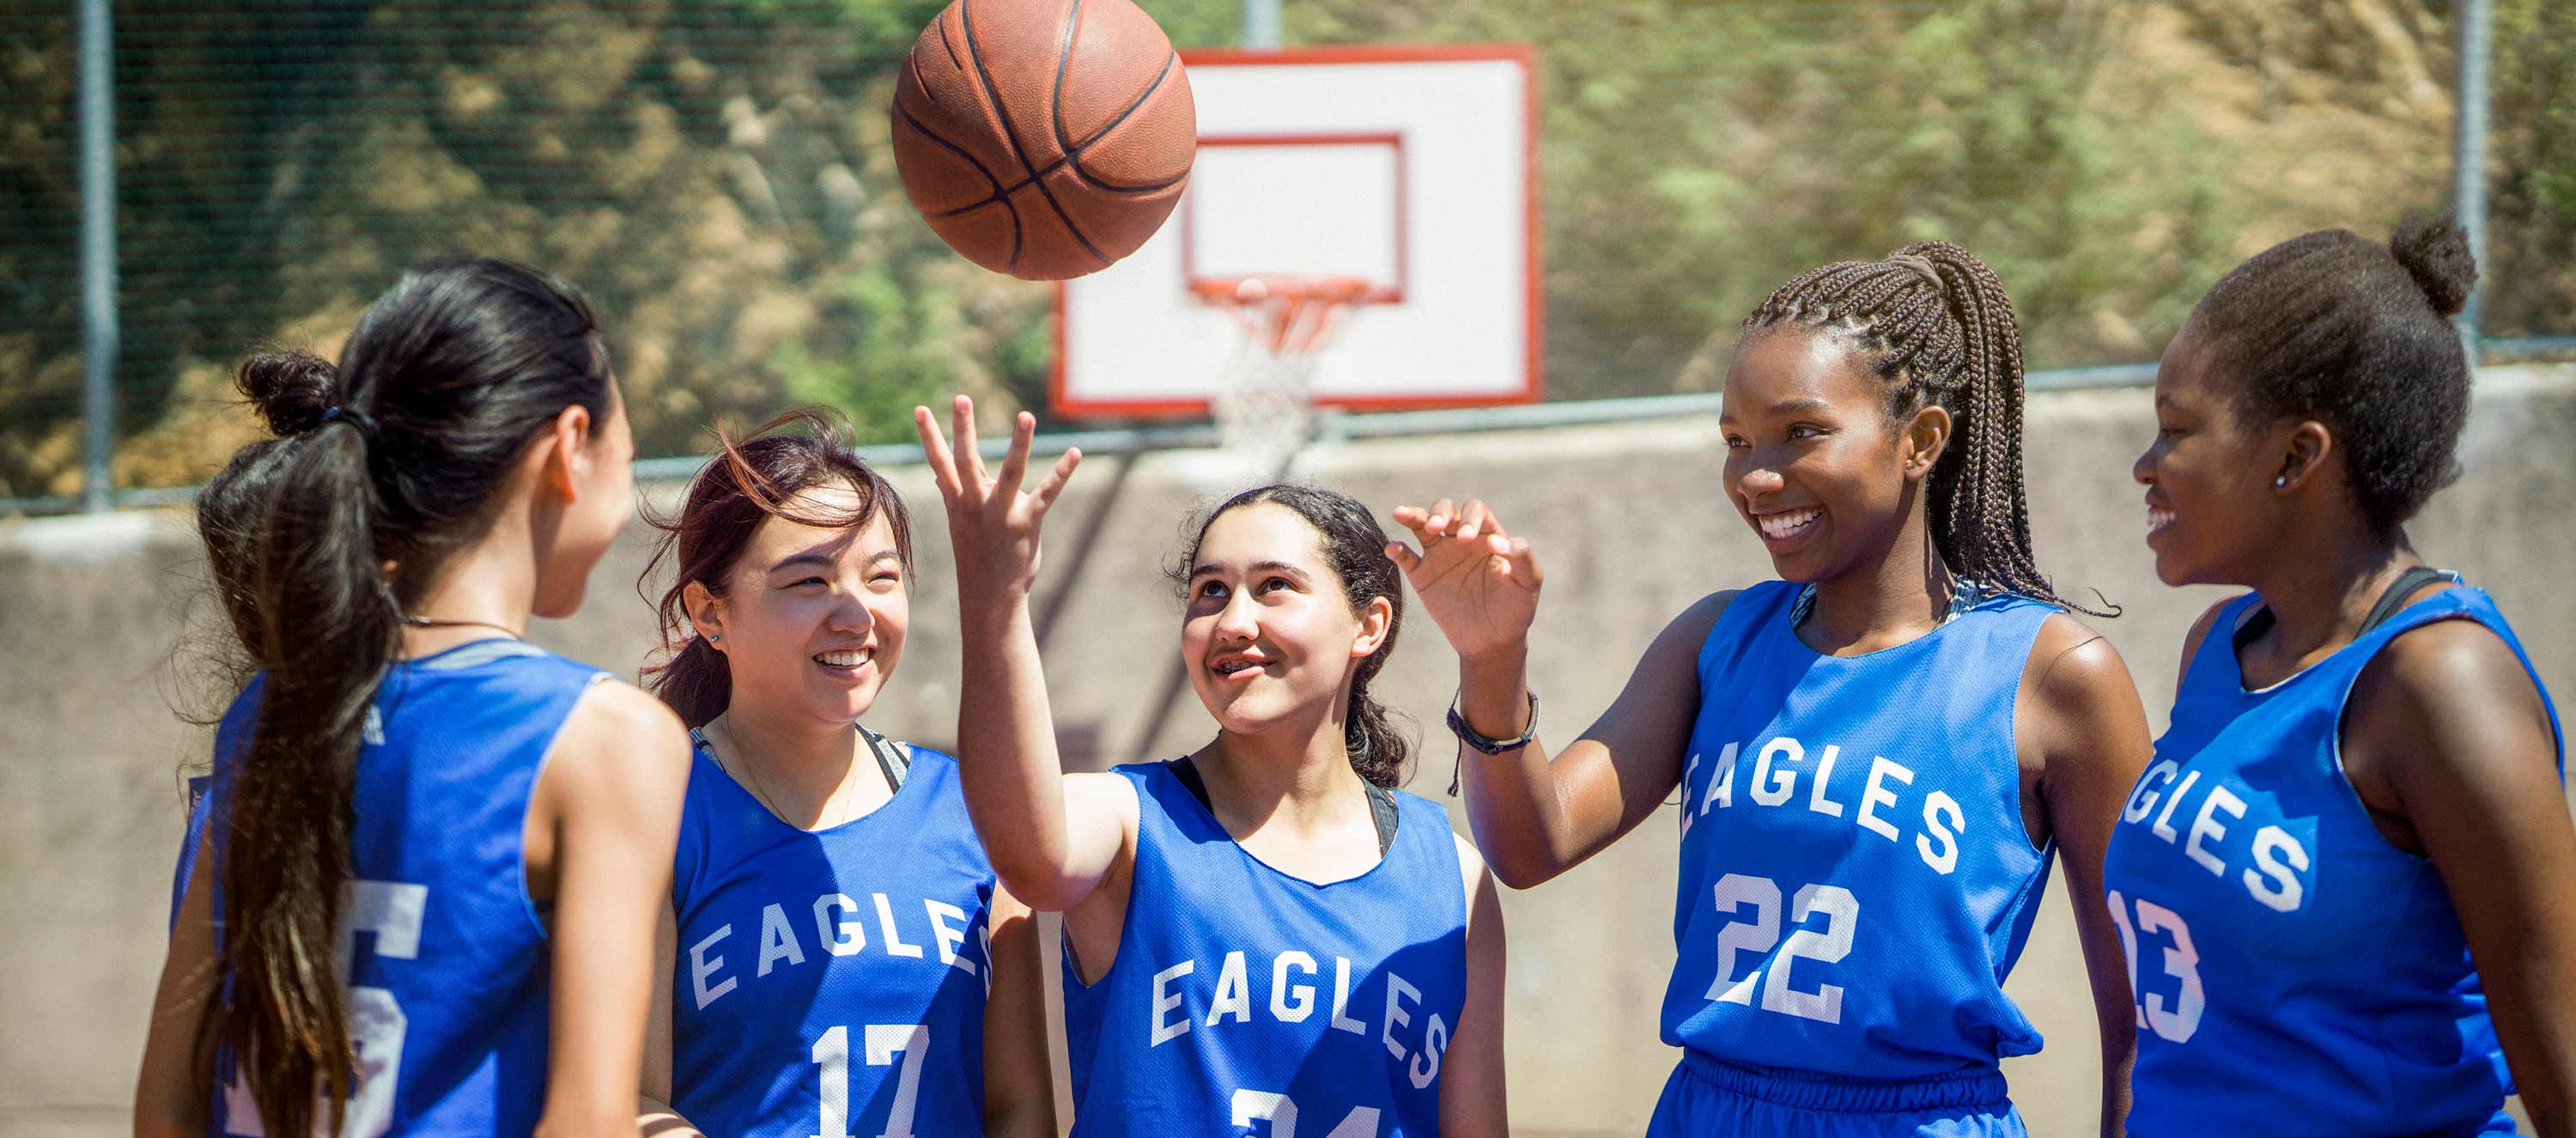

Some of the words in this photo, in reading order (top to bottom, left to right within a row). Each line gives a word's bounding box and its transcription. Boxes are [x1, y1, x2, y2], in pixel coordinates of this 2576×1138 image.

[1680, 736, 1965, 874] EAGLES
[1704, 873, 1860, 1024] 22
[2107, 889, 2206, 1044] 13
[809, 1025, 930, 1138] 17
[1151, 950, 1447, 1089] EAGLES
